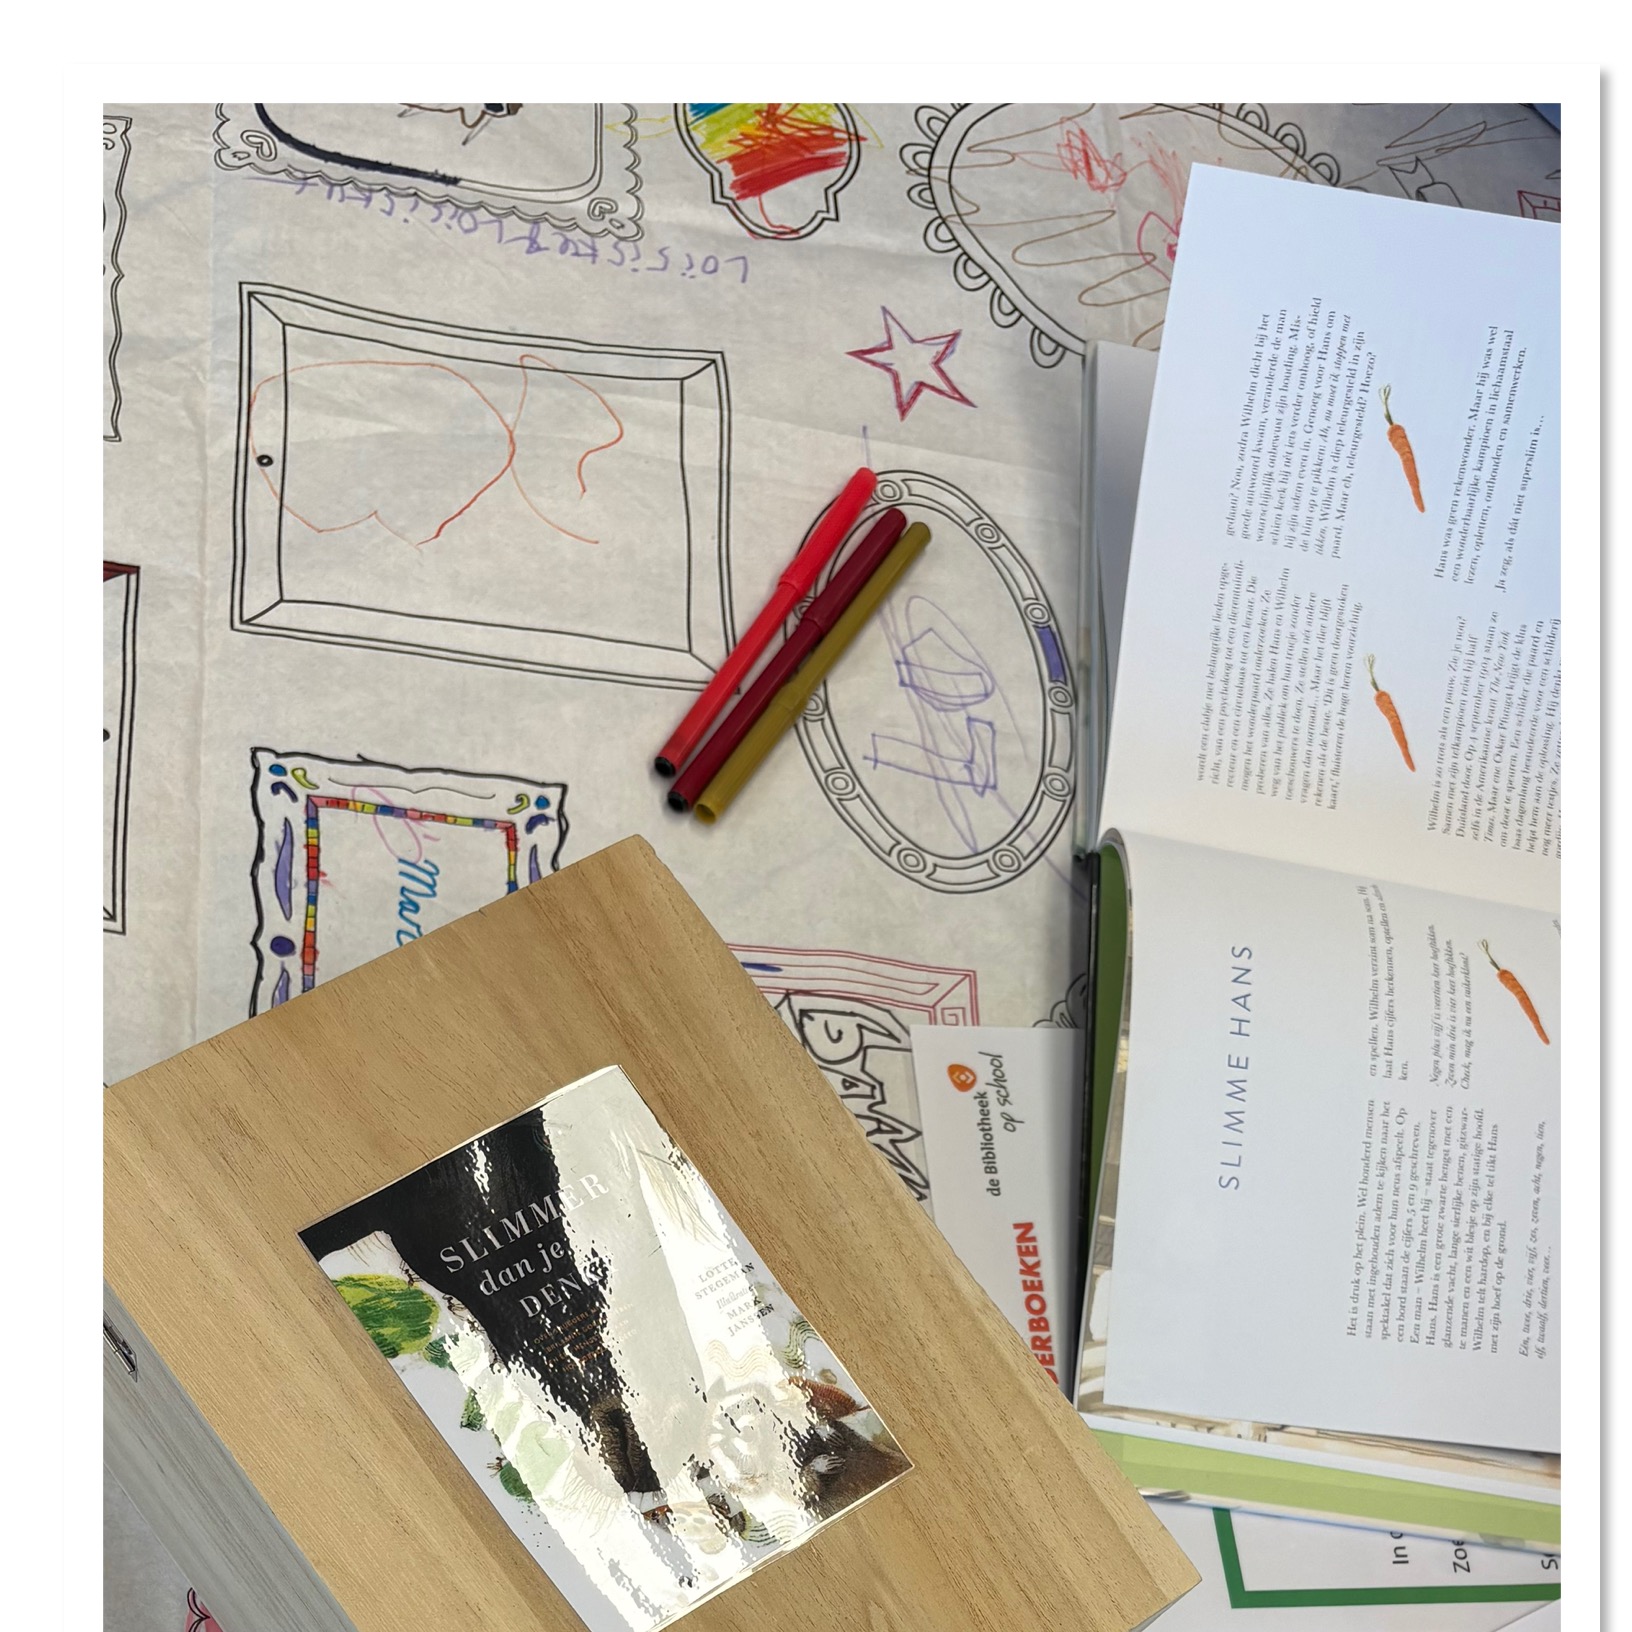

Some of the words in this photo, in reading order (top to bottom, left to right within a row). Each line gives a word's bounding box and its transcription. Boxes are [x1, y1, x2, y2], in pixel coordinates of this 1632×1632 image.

[1225, 945, 1256, 1036] HANS
[988, 1051, 1010, 1106] school
[978, 1091, 998, 1175] Bibliotheek
[1001, 1112, 1025, 1133] op
[1217, 1054, 1249, 1190] SLIMME
[1365, 1099, 1374, 1138] mensen
[1358, 1140, 1371, 1184] honderd
[1375, 1147, 1387, 1177] kijken
[985, 1178, 1001, 1196] de
[1356, 1187, 1367, 1207] Wel
[438, 1171, 609, 1273] SLIMMER
[1372, 1193, 1383, 1222] adem
[1354, 1211, 1366, 1240] plein.
[1352, 1242, 1363, 1259] het
[1366, 1224, 1380, 1285] ingehouden
[479, 1253, 535, 1297] dan
[535, 1237, 569, 1278] je
[695, 1261, 756, 1301] STEGEMAN
[699, 1257, 737, 1285] LOTTE
[1354, 1261, 1363, 1275] op
[1349, 1278, 1360, 1303] druk
[1367, 1288, 1375, 1308] met
[1348, 1306, 1357, 1314] is
[1364, 1310, 1373, 1338] staan
[1346, 1317, 1357, 1336] Het
[1392, 1545, 1408, 1564] In
